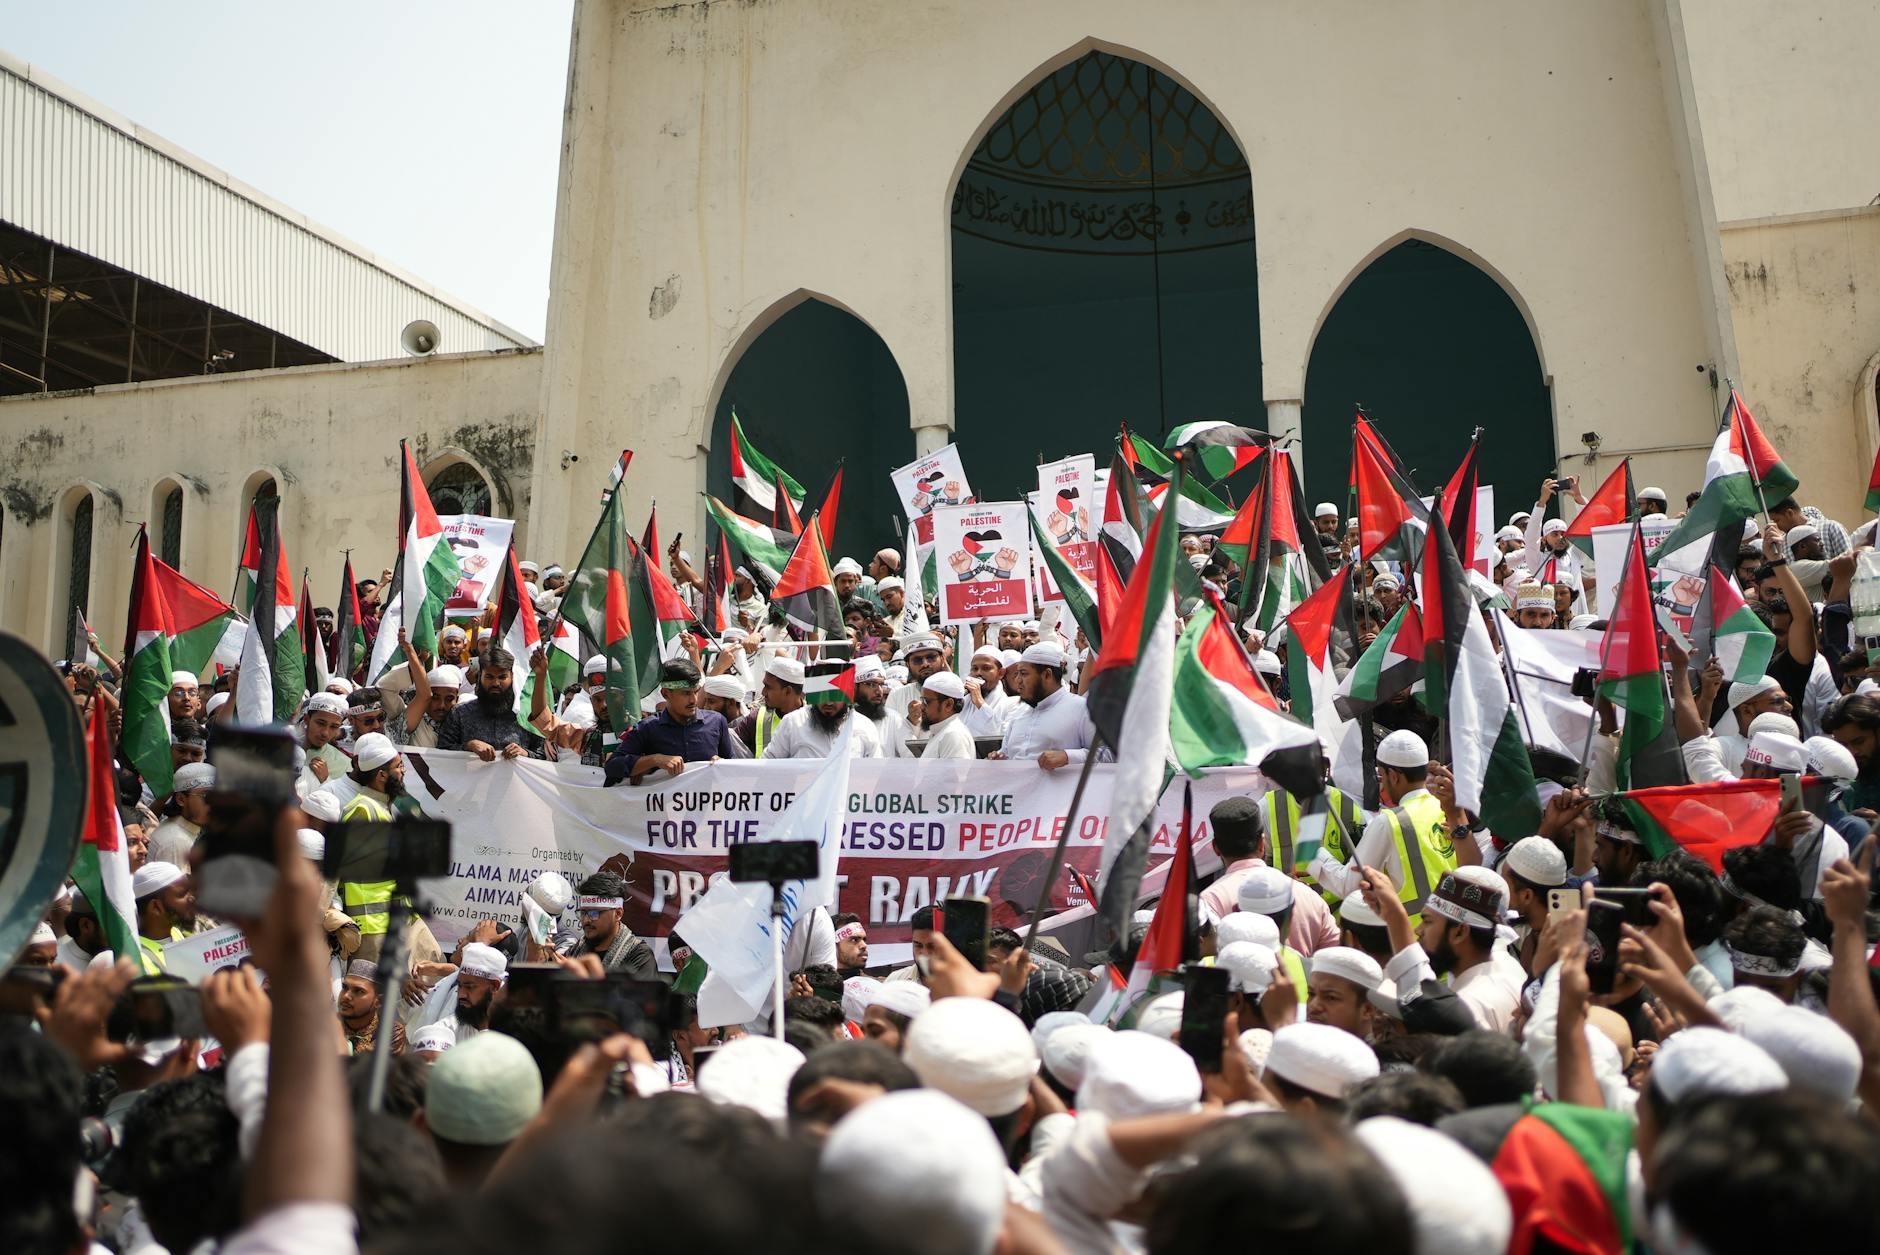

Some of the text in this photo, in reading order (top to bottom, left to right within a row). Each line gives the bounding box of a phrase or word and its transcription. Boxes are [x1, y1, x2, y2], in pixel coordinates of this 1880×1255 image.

[960, 516, 1002, 526] PALESTINE
[444, 525, 485, 536] PALESTINE
[968, 583, 1002, 596] الحرية
[963, 595, 1010, 610] لفلسطين
[646, 792, 1013, 815] IN SUPPORT OF GLOBAL STRIKE
[647, 820, 698, 848] FOR
[958, 815, 1067, 852] PEOPLE
[532, 847, 584, 864] Organized by
[214, 934, 239, 947] FREEDOM
